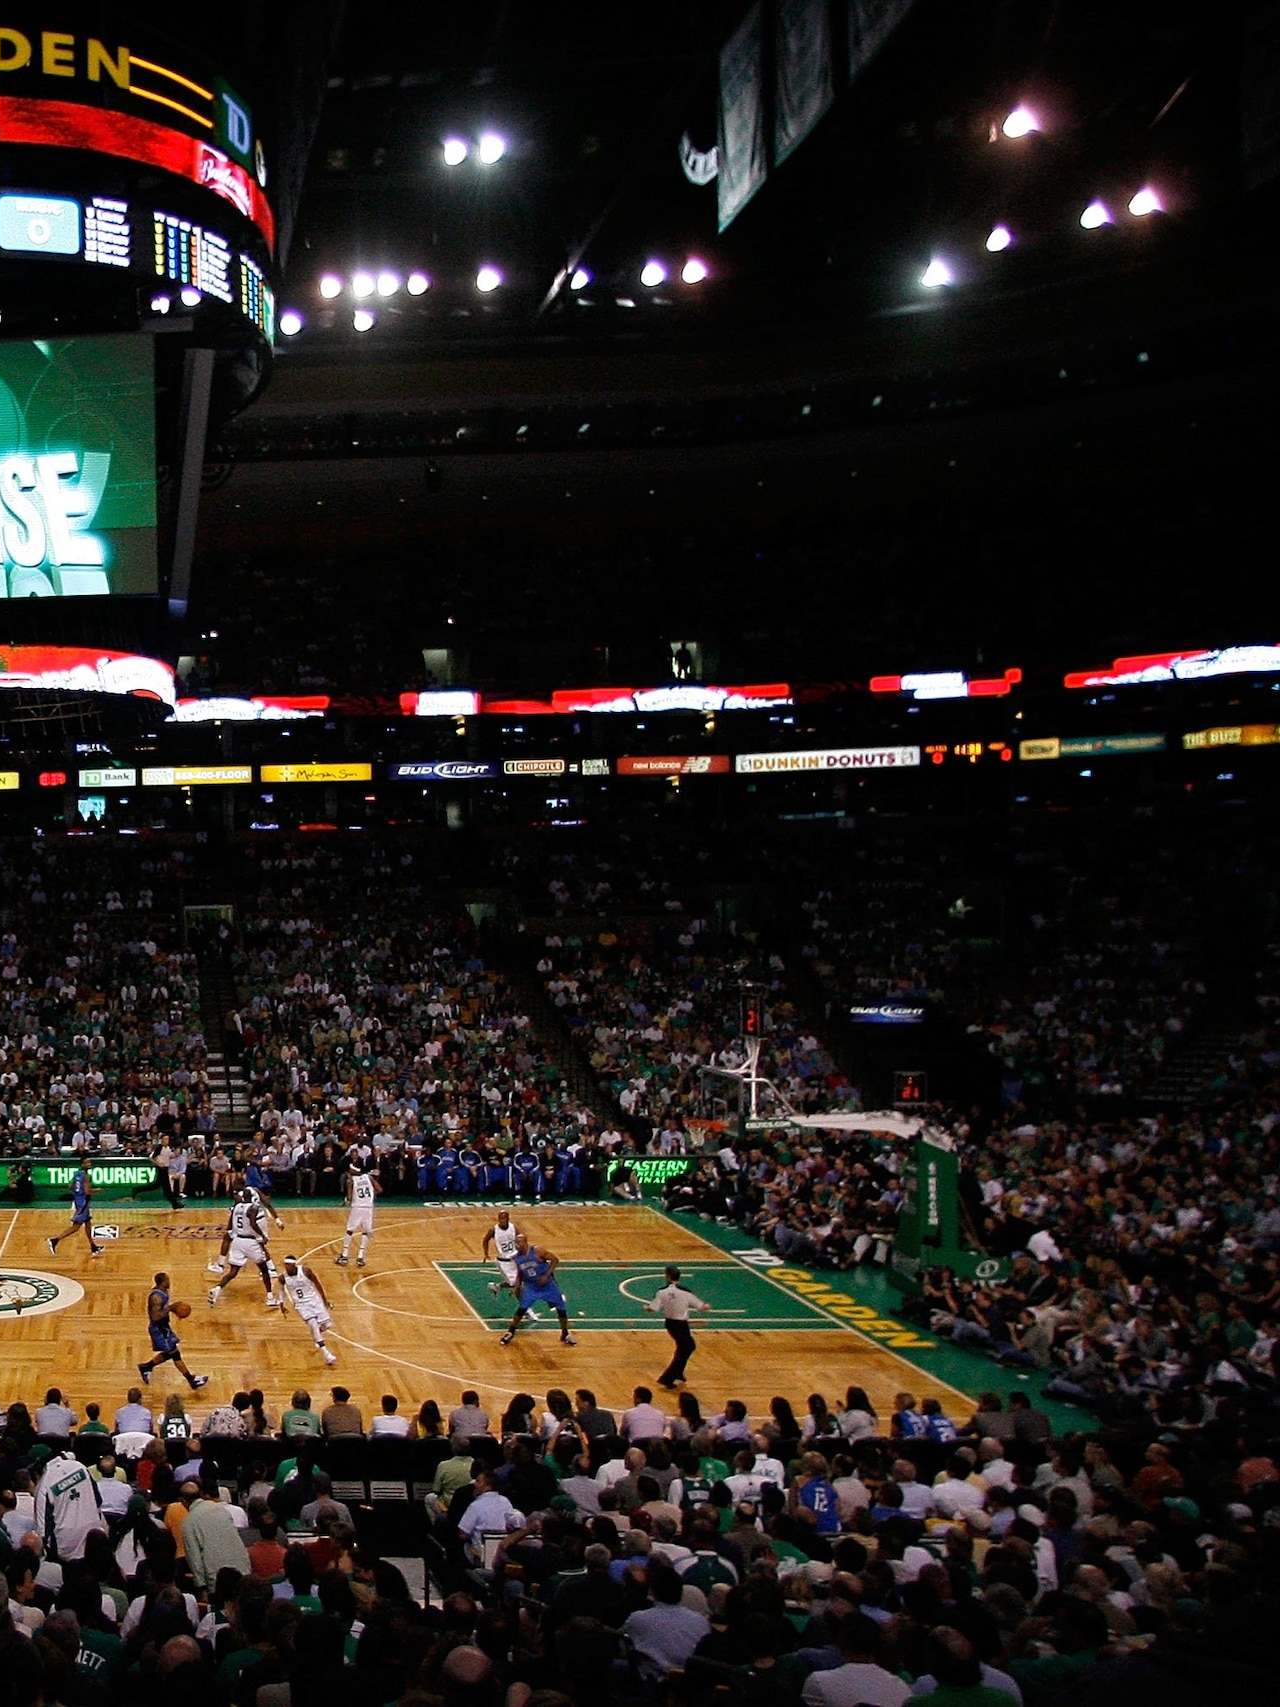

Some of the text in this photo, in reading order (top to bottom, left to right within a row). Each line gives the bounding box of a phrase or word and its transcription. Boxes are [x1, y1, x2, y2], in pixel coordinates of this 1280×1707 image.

[222, 92, 252, 155] TD
[27, 217, 52, 245] 0
[517, 762, 562, 771] CHIPOTLE
[753, 752, 896, 770] DUNKIN' DONUTS
[105, 772, 130, 781] Bank
[398, 765, 489, 775] BUD LIGHT
[87, 1166, 157, 1184] OURNEY
[357, 1187, 371, 1199] 34
[236, 1216, 244, 1229] 5
[501, 1241, 515, 1253] 20
[766, 1268, 938, 1348] GARDEN
[167, 1423, 187, 1439] 34
[814, 1490, 829, 1512] 12
